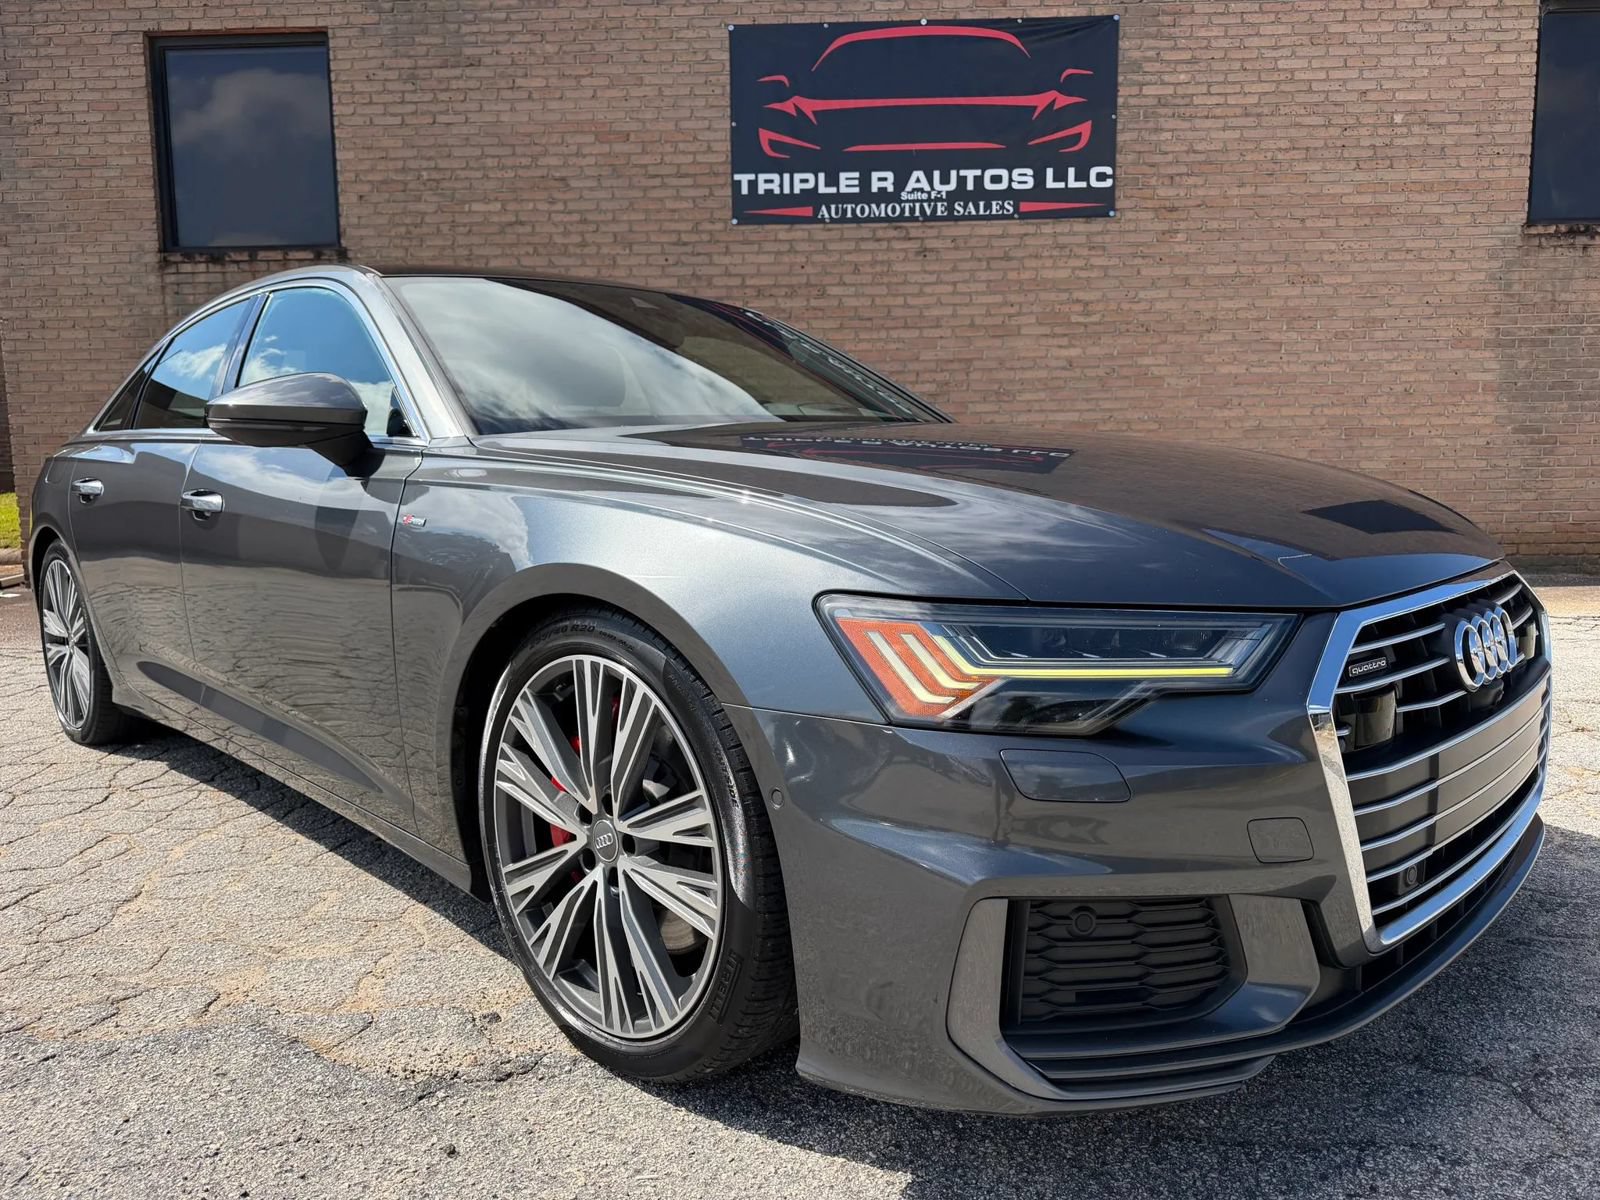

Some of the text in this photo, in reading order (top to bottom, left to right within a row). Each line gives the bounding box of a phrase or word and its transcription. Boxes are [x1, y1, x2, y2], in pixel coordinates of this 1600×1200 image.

[733, 166, 1113, 195] TRIPLE R AUTOS LLC
[900, 190, 946, 200] Suite F-1
[817, 200, 1014, 219] AUTOMOTIVE SALES
[1351, 660, 1386, 675] quattro
